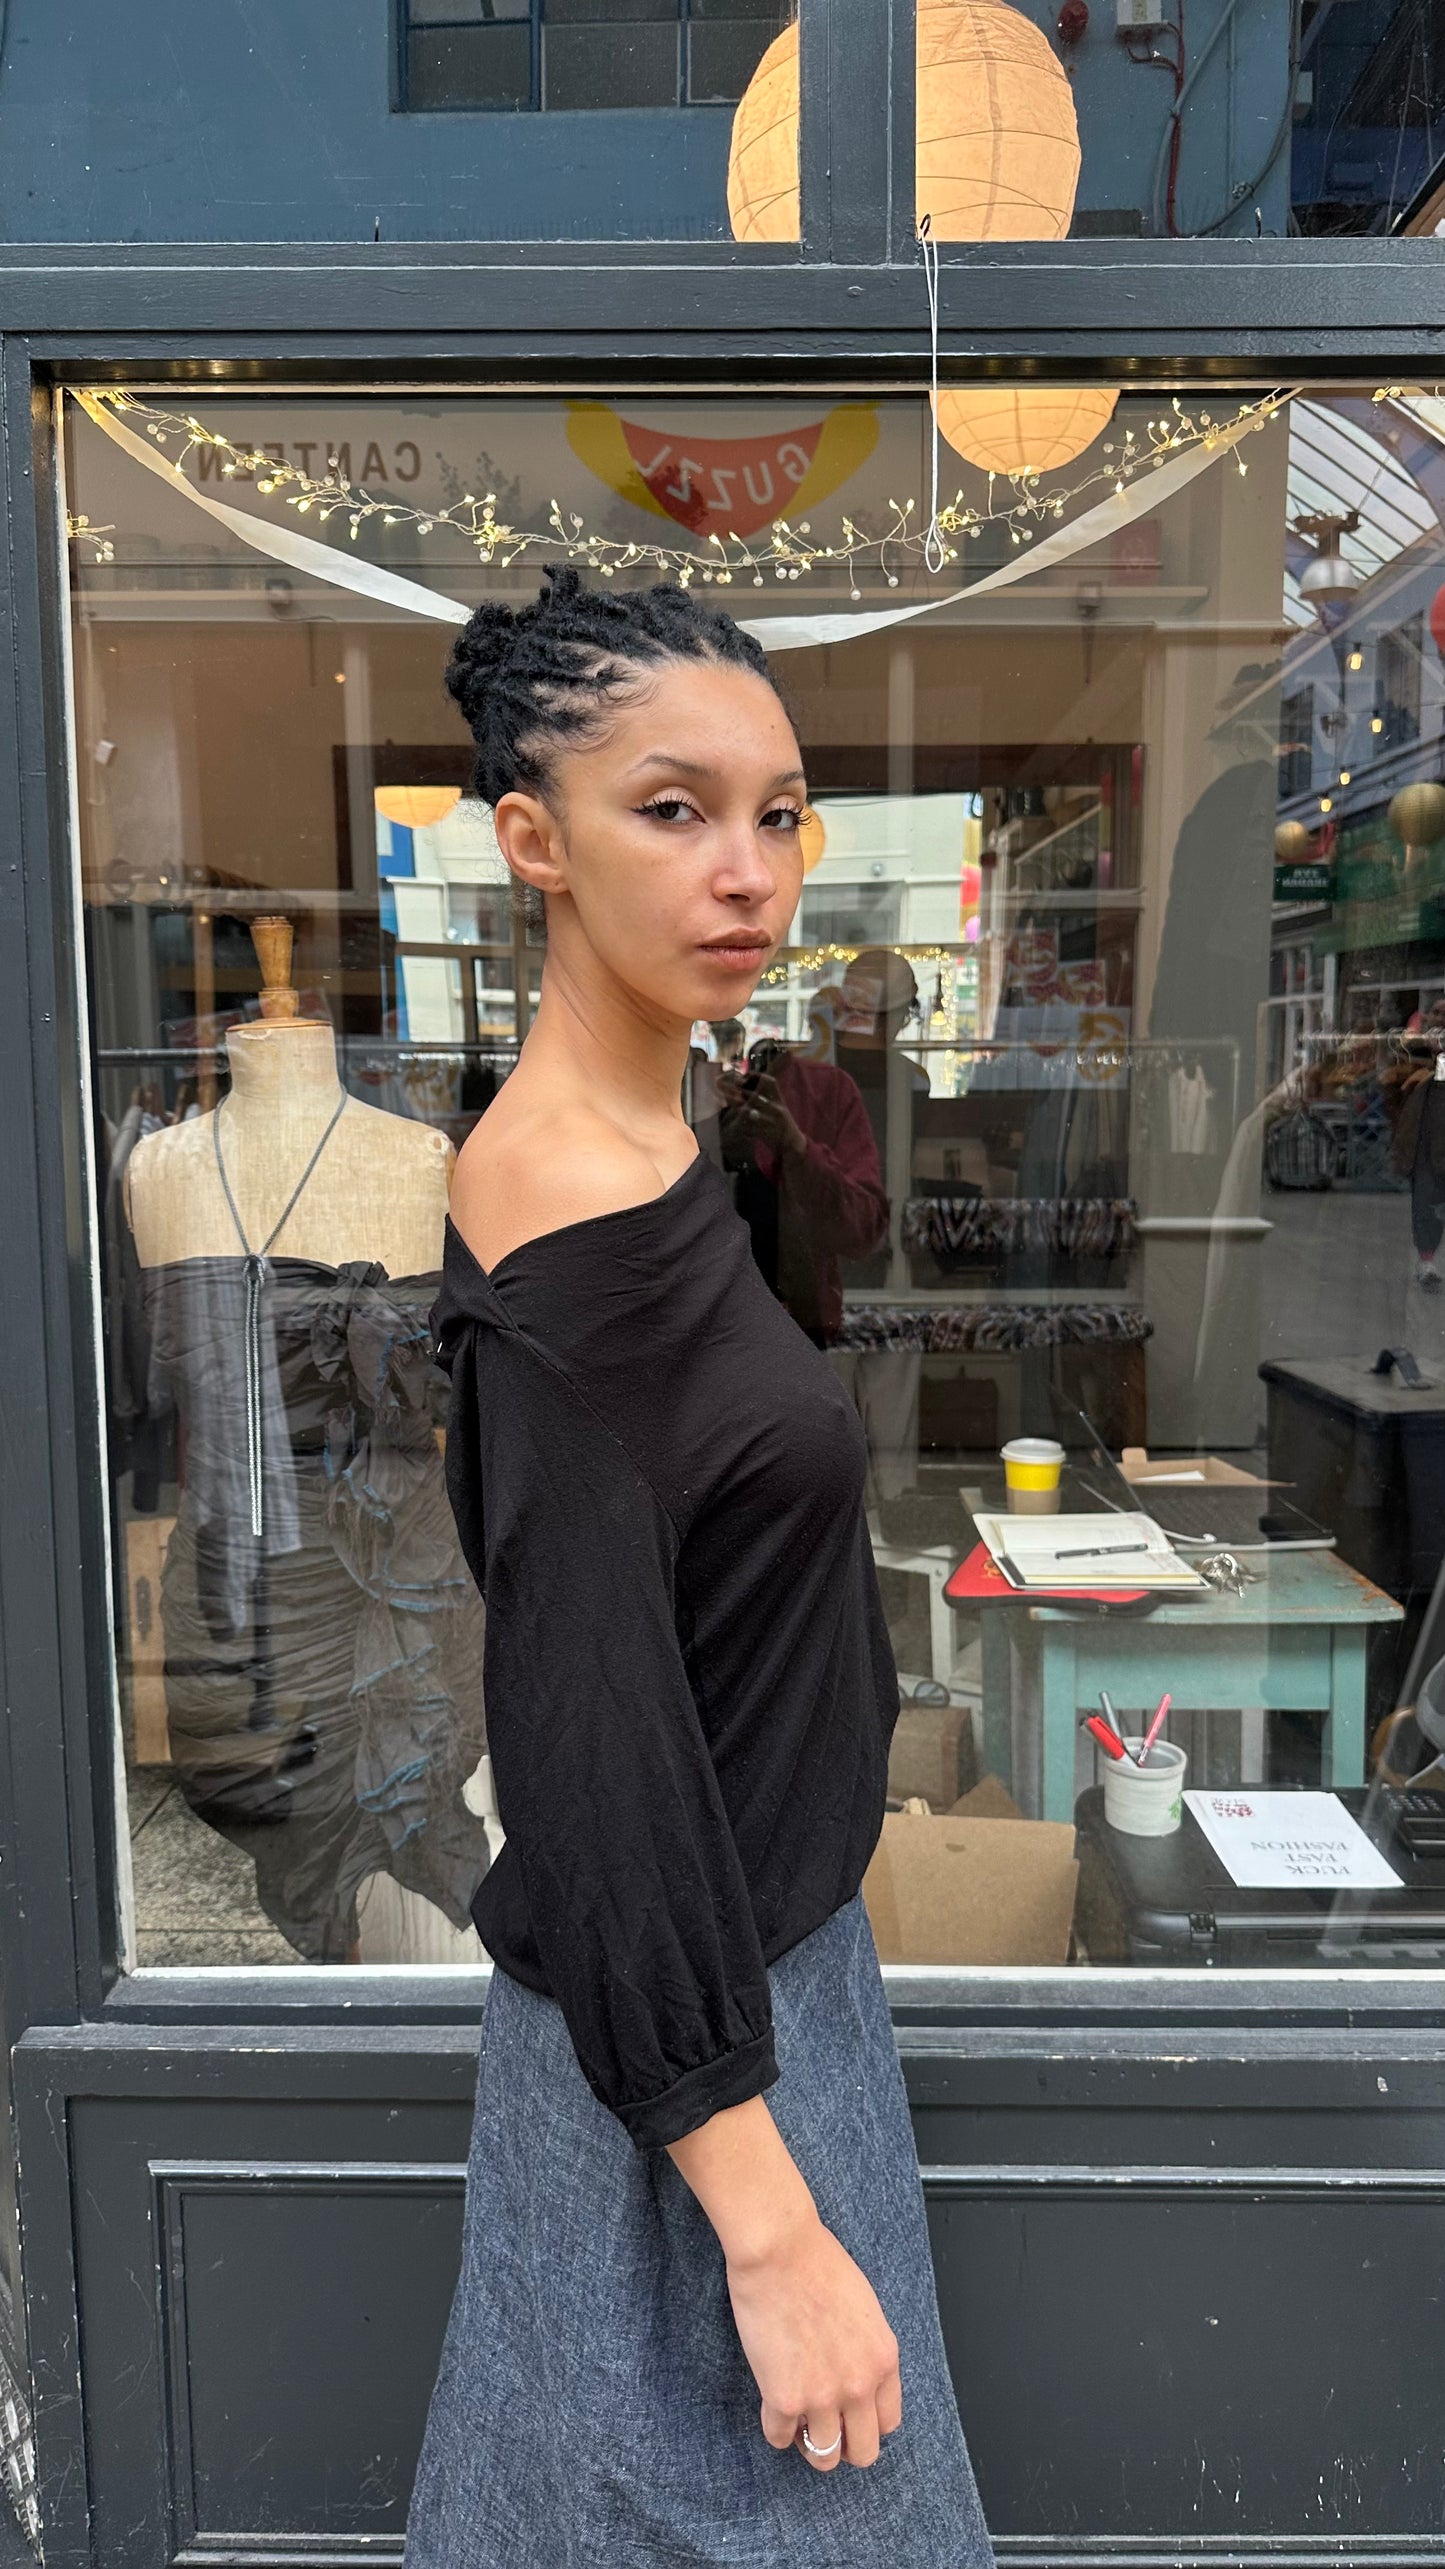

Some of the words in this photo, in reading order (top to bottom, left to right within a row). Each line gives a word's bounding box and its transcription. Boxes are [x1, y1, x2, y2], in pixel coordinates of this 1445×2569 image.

[1250, 1840, 1349, 1851] FASHION
[1284, 1852, 1338, 1863] FAST
[1284, 1864, 1351, 1875] FUCK
